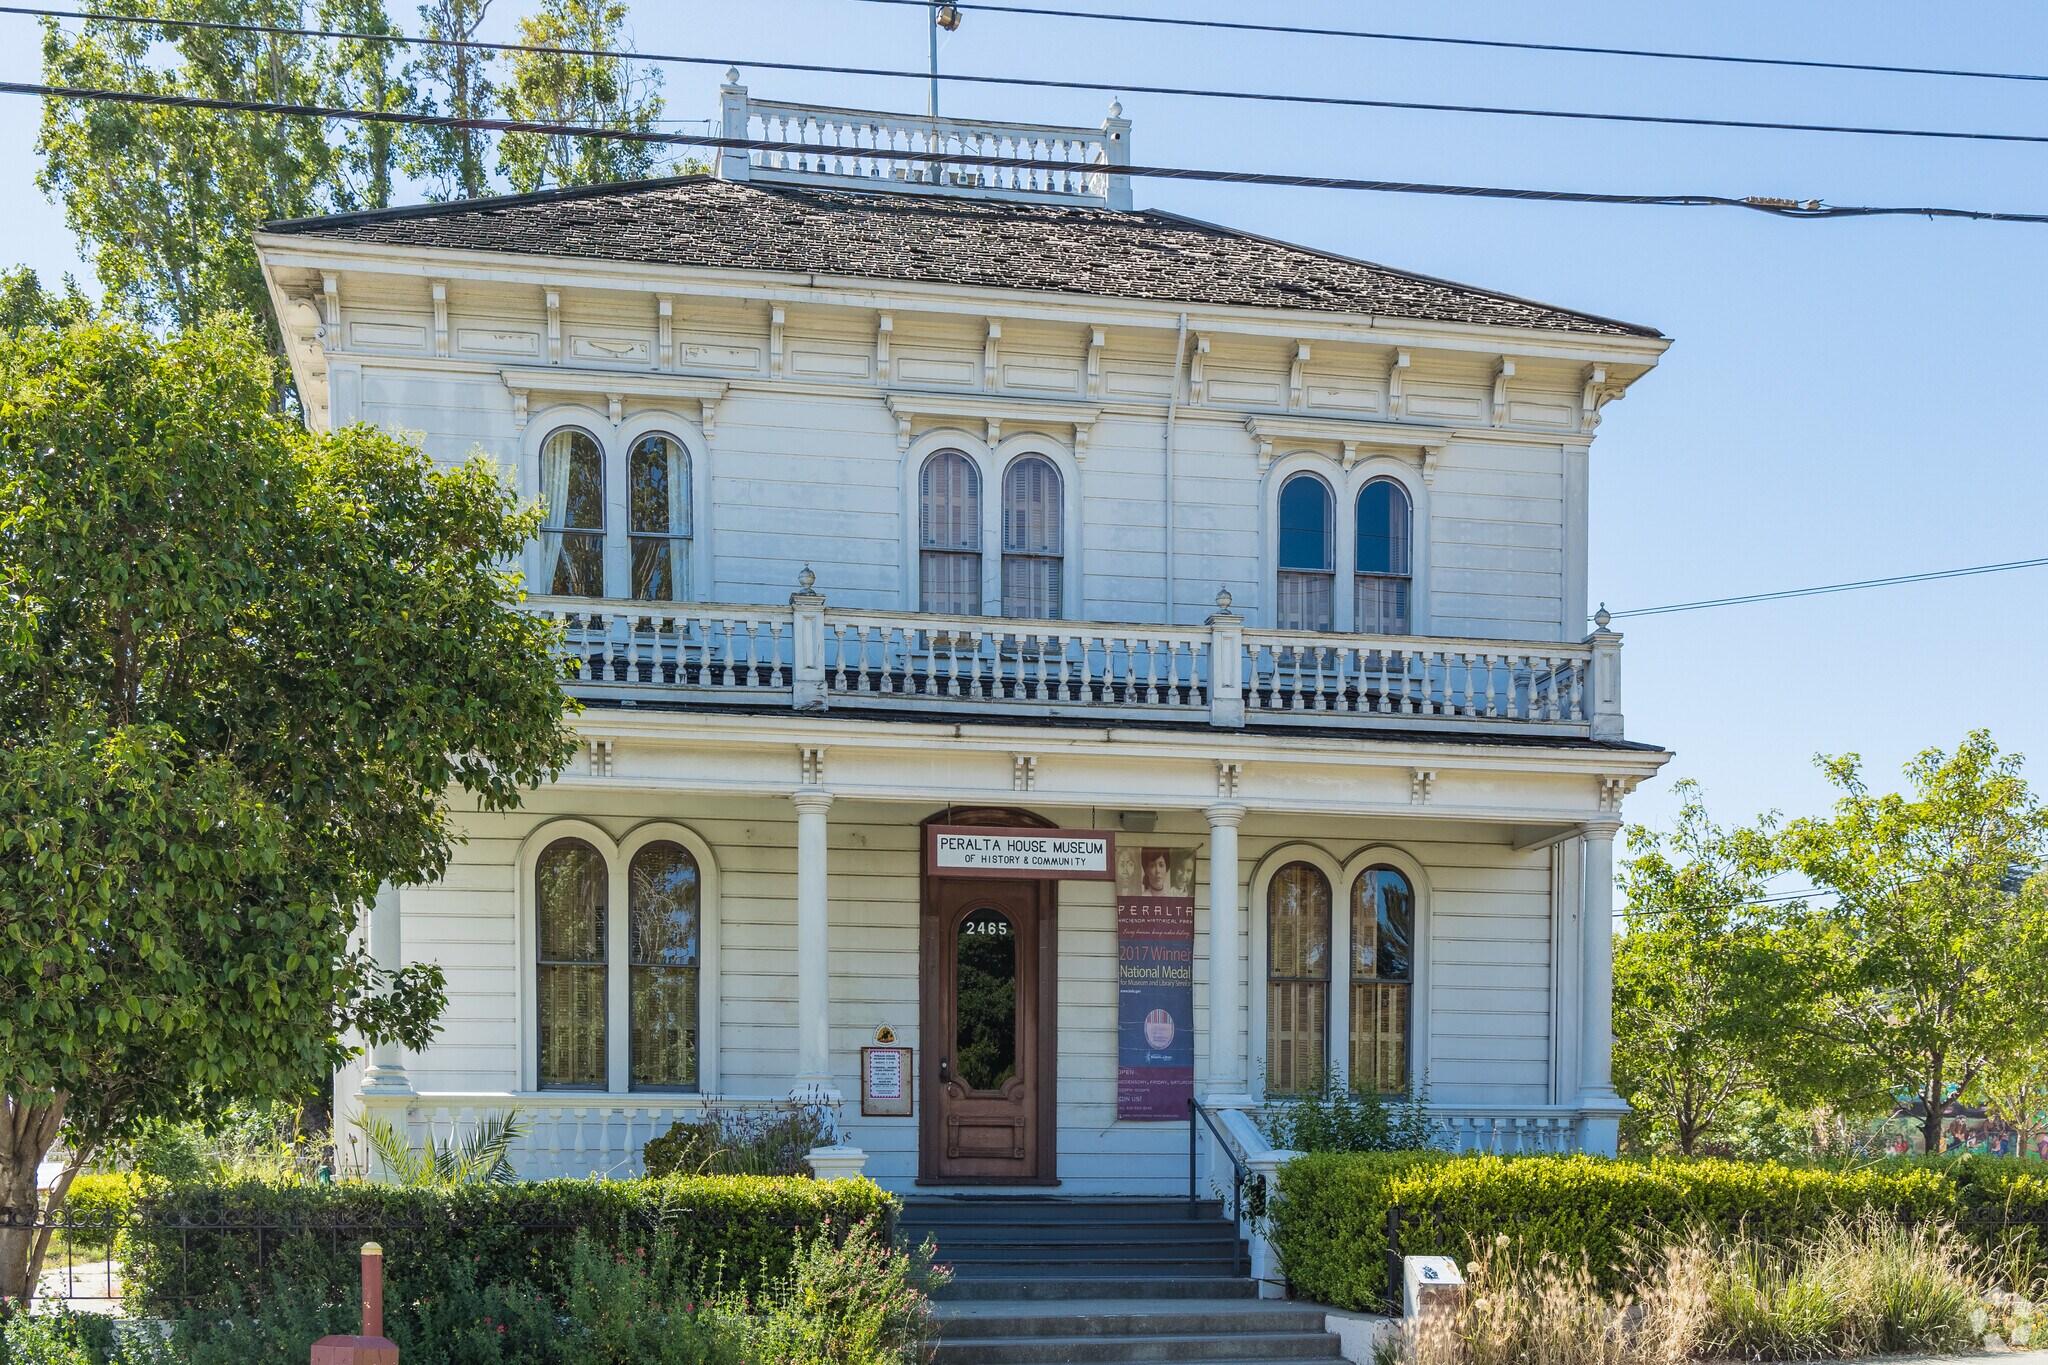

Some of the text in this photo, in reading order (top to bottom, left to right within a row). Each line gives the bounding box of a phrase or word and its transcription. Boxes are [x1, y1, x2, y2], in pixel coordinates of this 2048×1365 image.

[940, 838, 1103, 854] PERALTA HOUSE MUSEUM
[964, 854, 1086, 866] OF HISTORY & COMMUNITY
[1118, 905, 1193, 916] PERALTA
[966, 921, 1007, 935] 2465
[1119, 945, 1192, 962] 2017 Winner
[1120, 964, 1191, 979] National Medal
[1159, 979, 1175, 988] Library
